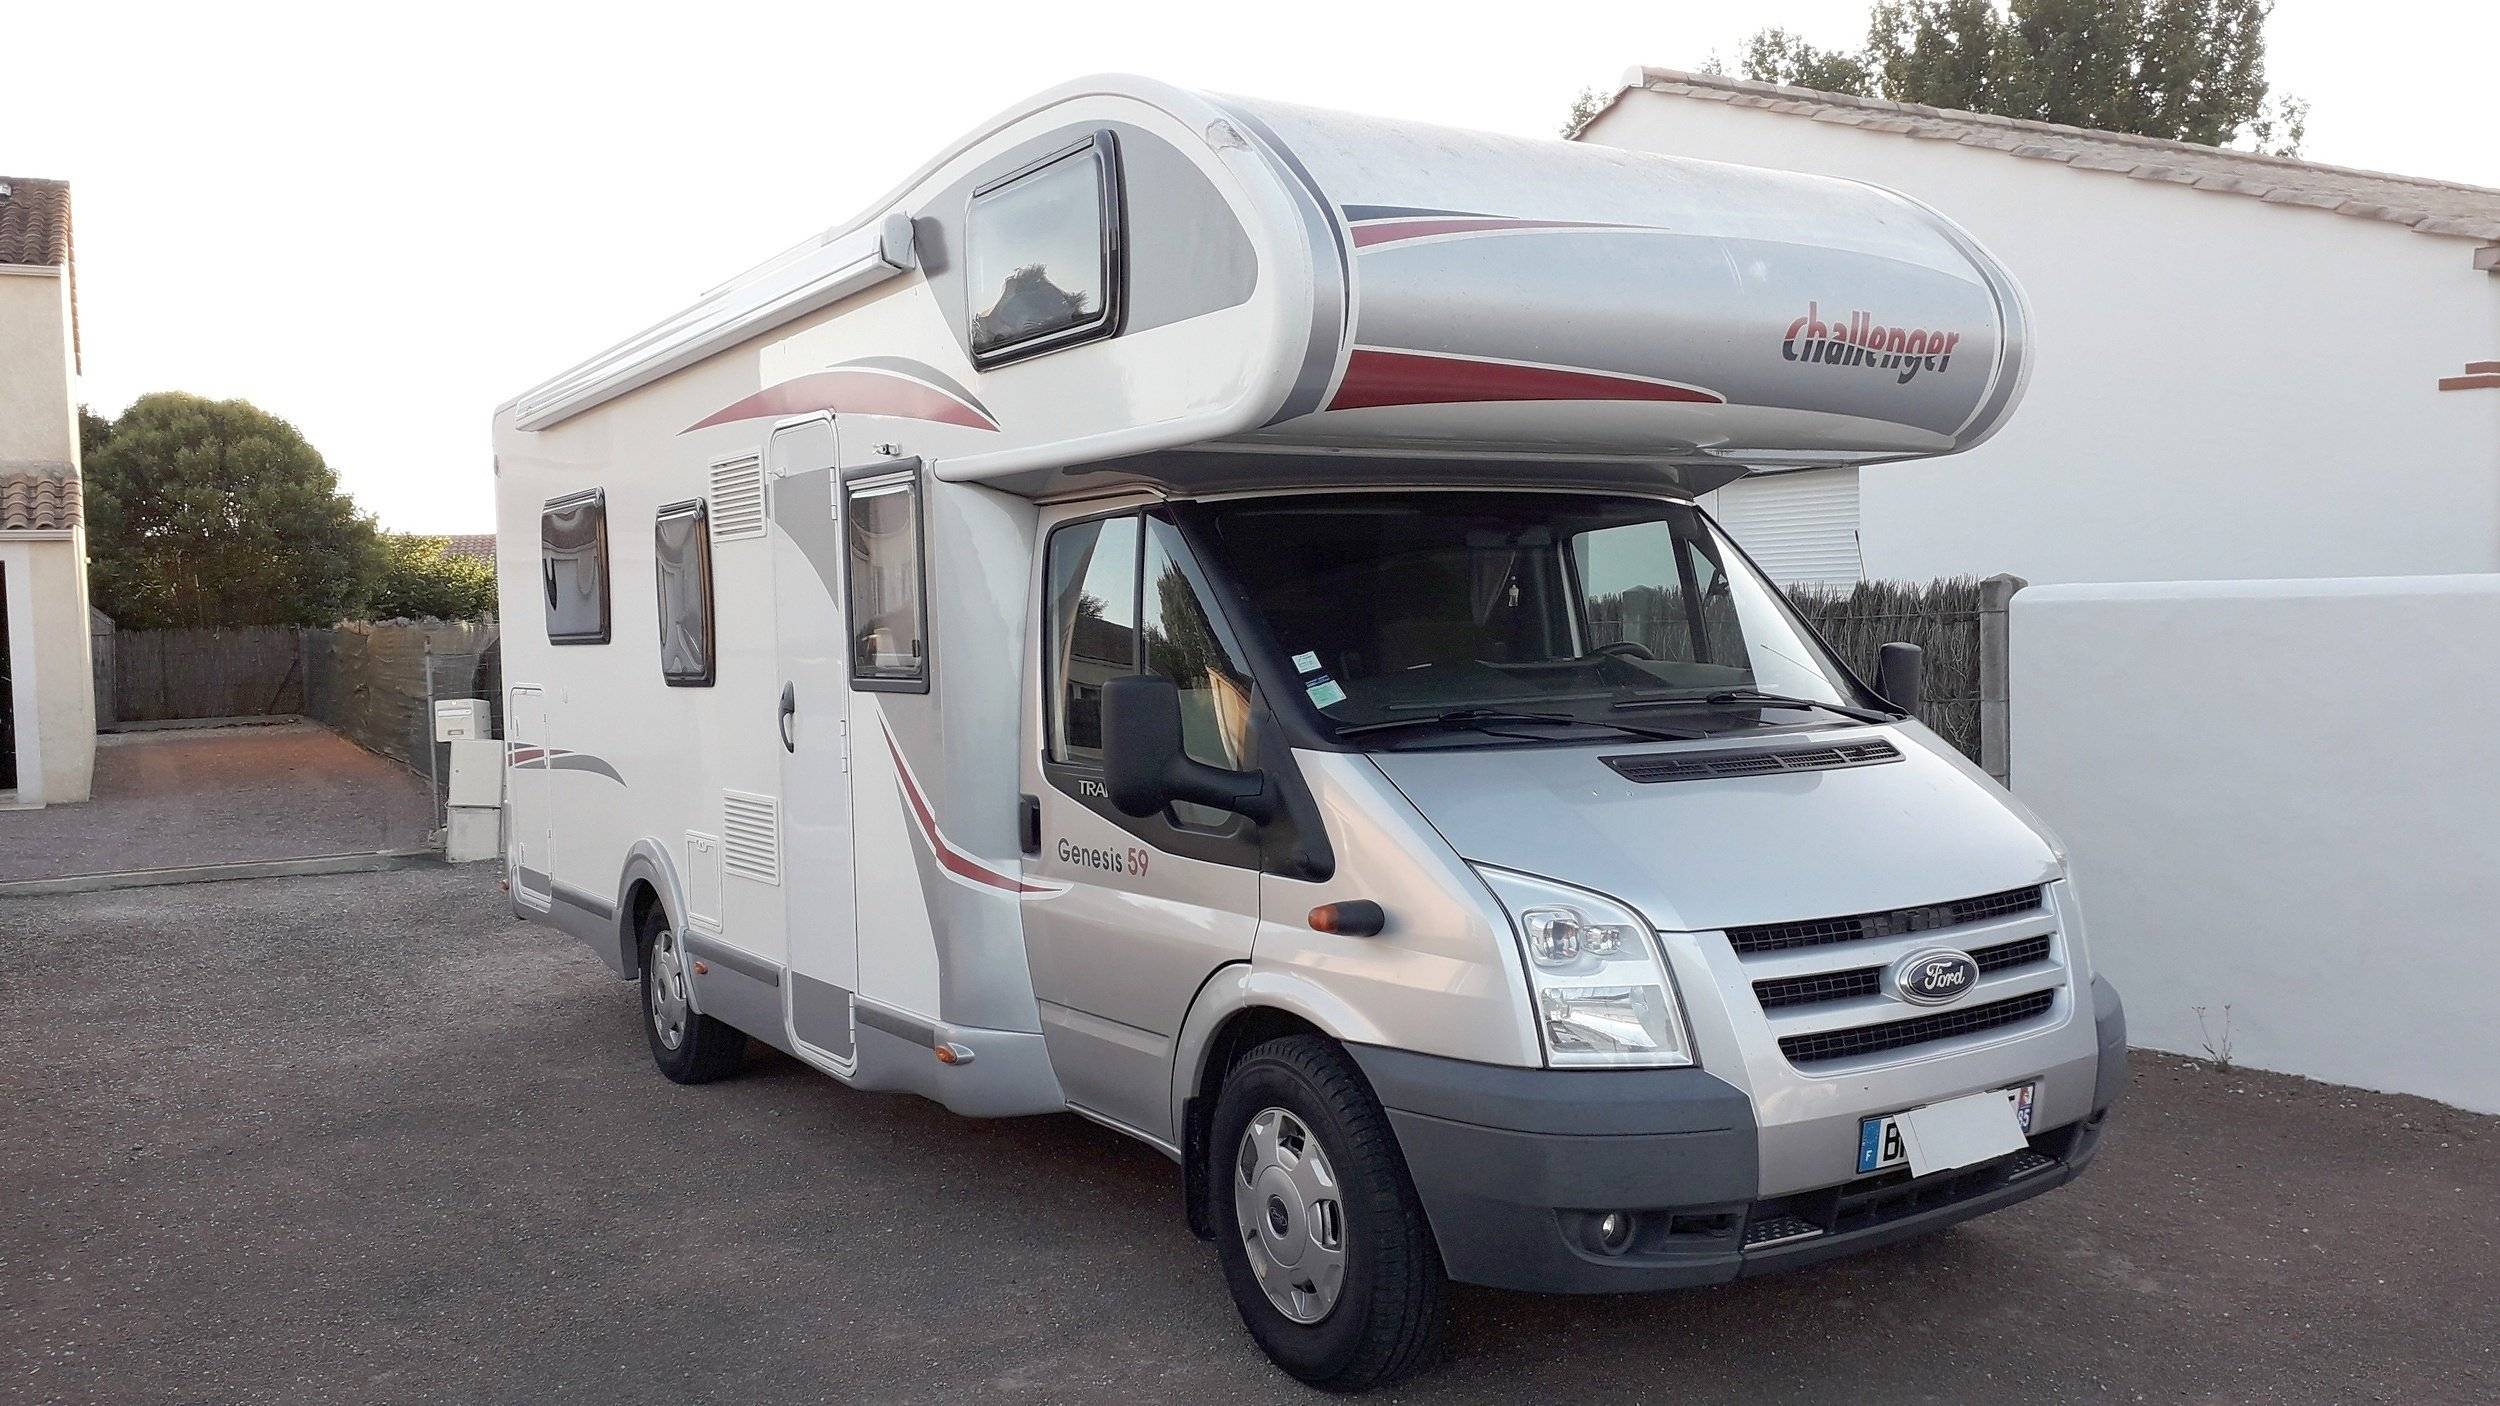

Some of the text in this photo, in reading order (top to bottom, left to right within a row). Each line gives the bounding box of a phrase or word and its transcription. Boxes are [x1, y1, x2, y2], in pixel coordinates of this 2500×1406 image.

[1782, 300, 1960, 385] challenger
[1058, 837, 1149, 877] Genesis 59
[1924, 961, 1966, 990] Ford
